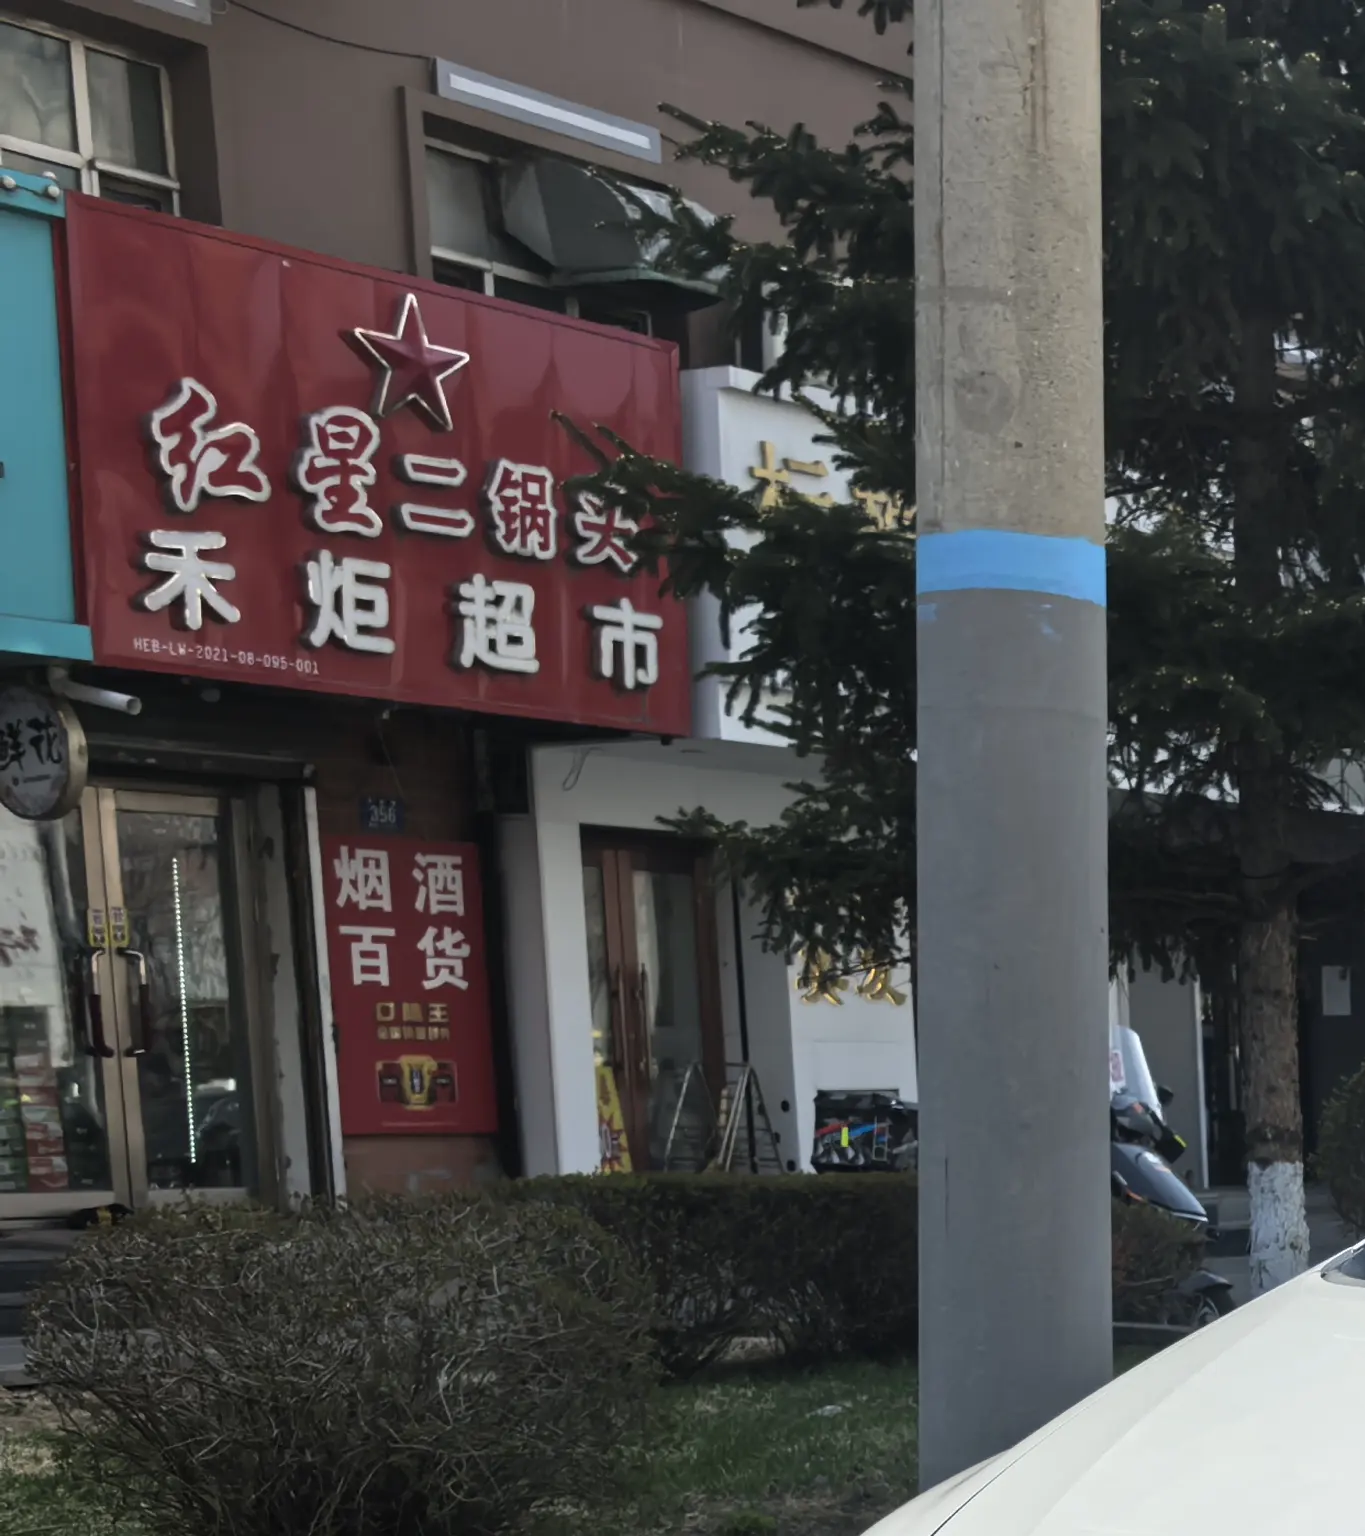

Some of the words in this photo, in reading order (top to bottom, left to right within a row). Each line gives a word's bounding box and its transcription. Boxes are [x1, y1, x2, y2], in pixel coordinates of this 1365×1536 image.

[152, 378, 640, 572] 红星二锅头
[144, 529, 662, 690] 禾炬超市
[333, 845, 465, 917] 烟酒
[338, 925, 471, 990] 百货
